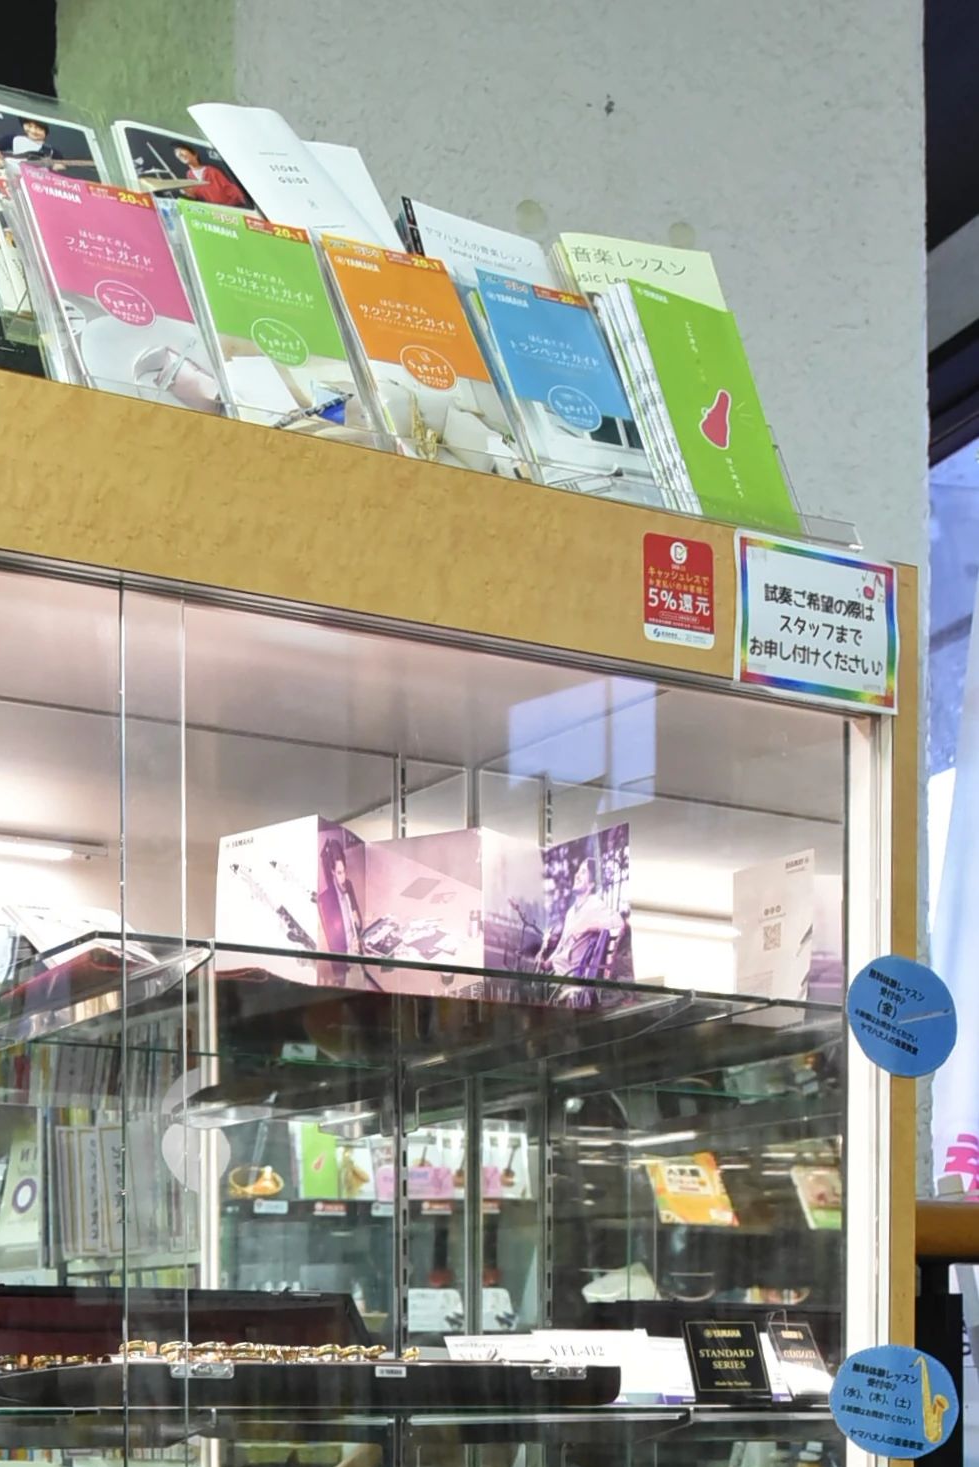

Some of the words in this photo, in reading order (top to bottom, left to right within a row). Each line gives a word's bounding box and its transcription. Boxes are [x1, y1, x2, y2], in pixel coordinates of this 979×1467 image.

[277, 176, 310, 185] GUIDE
[42, 185, 82, 204] YAMAHA
[202, 223, 239, 241] YAMAHA
[64, 235, 153, 266] フルートガイド
[572, 246, 686, 276] 音楽レッスン
[344, 258, 381, 273] YAMAHA
[215, 271, 314, 303] クラリネットガイド
[497, 293, 530, 309] YAMAHA
[358, 303, 456, 331] サクソフォンガイド
[509, 339, 601, 368] トランペットガイド
[648, 566, 710, 586] キャッシュレスで
[648, 587, 711, 617] 5%還元
[764, 583, 876, 622] 試奏ご希望の際は
[779, 614, 864, 647] スタッフまで
[868, 968, 925, 1003] 無料体験レッスン
[712, 1328, 742, 1339] YAMAHA
[550, 1344, 606, 1357] YFL-412
[699, 1348, 755, 1359] STANDARD
[712, 1360, 747, 1371] SERIES
[852, 1362, 919, 1385] 無料体験レッスン
[849, 1427, 924, 1451] ヤマハ大人の音楽教室
